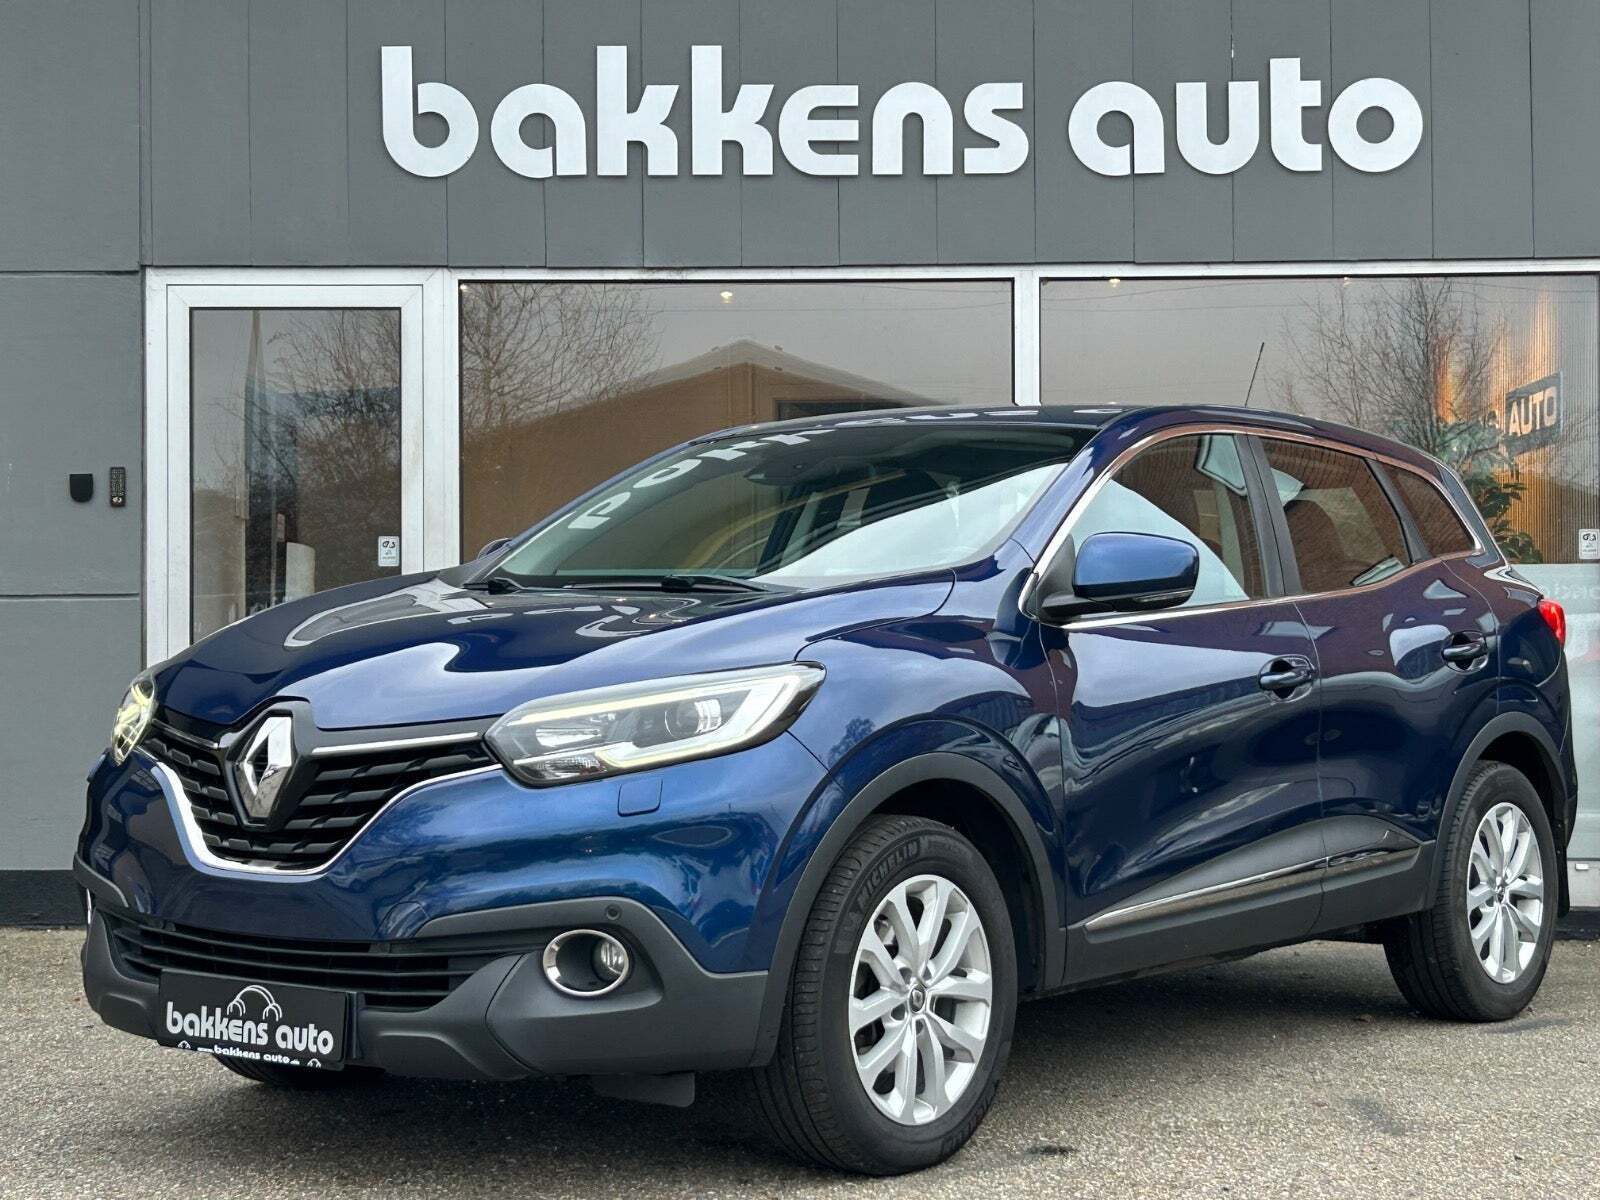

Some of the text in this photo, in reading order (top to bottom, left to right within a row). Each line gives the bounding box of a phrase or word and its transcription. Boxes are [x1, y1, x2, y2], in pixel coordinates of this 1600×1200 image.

[381, 45, 1424, 178] bakkens auto
[1509, 386, 1557, 436] AUTO
[166, 1001, 334, 1055] bakkens auto
